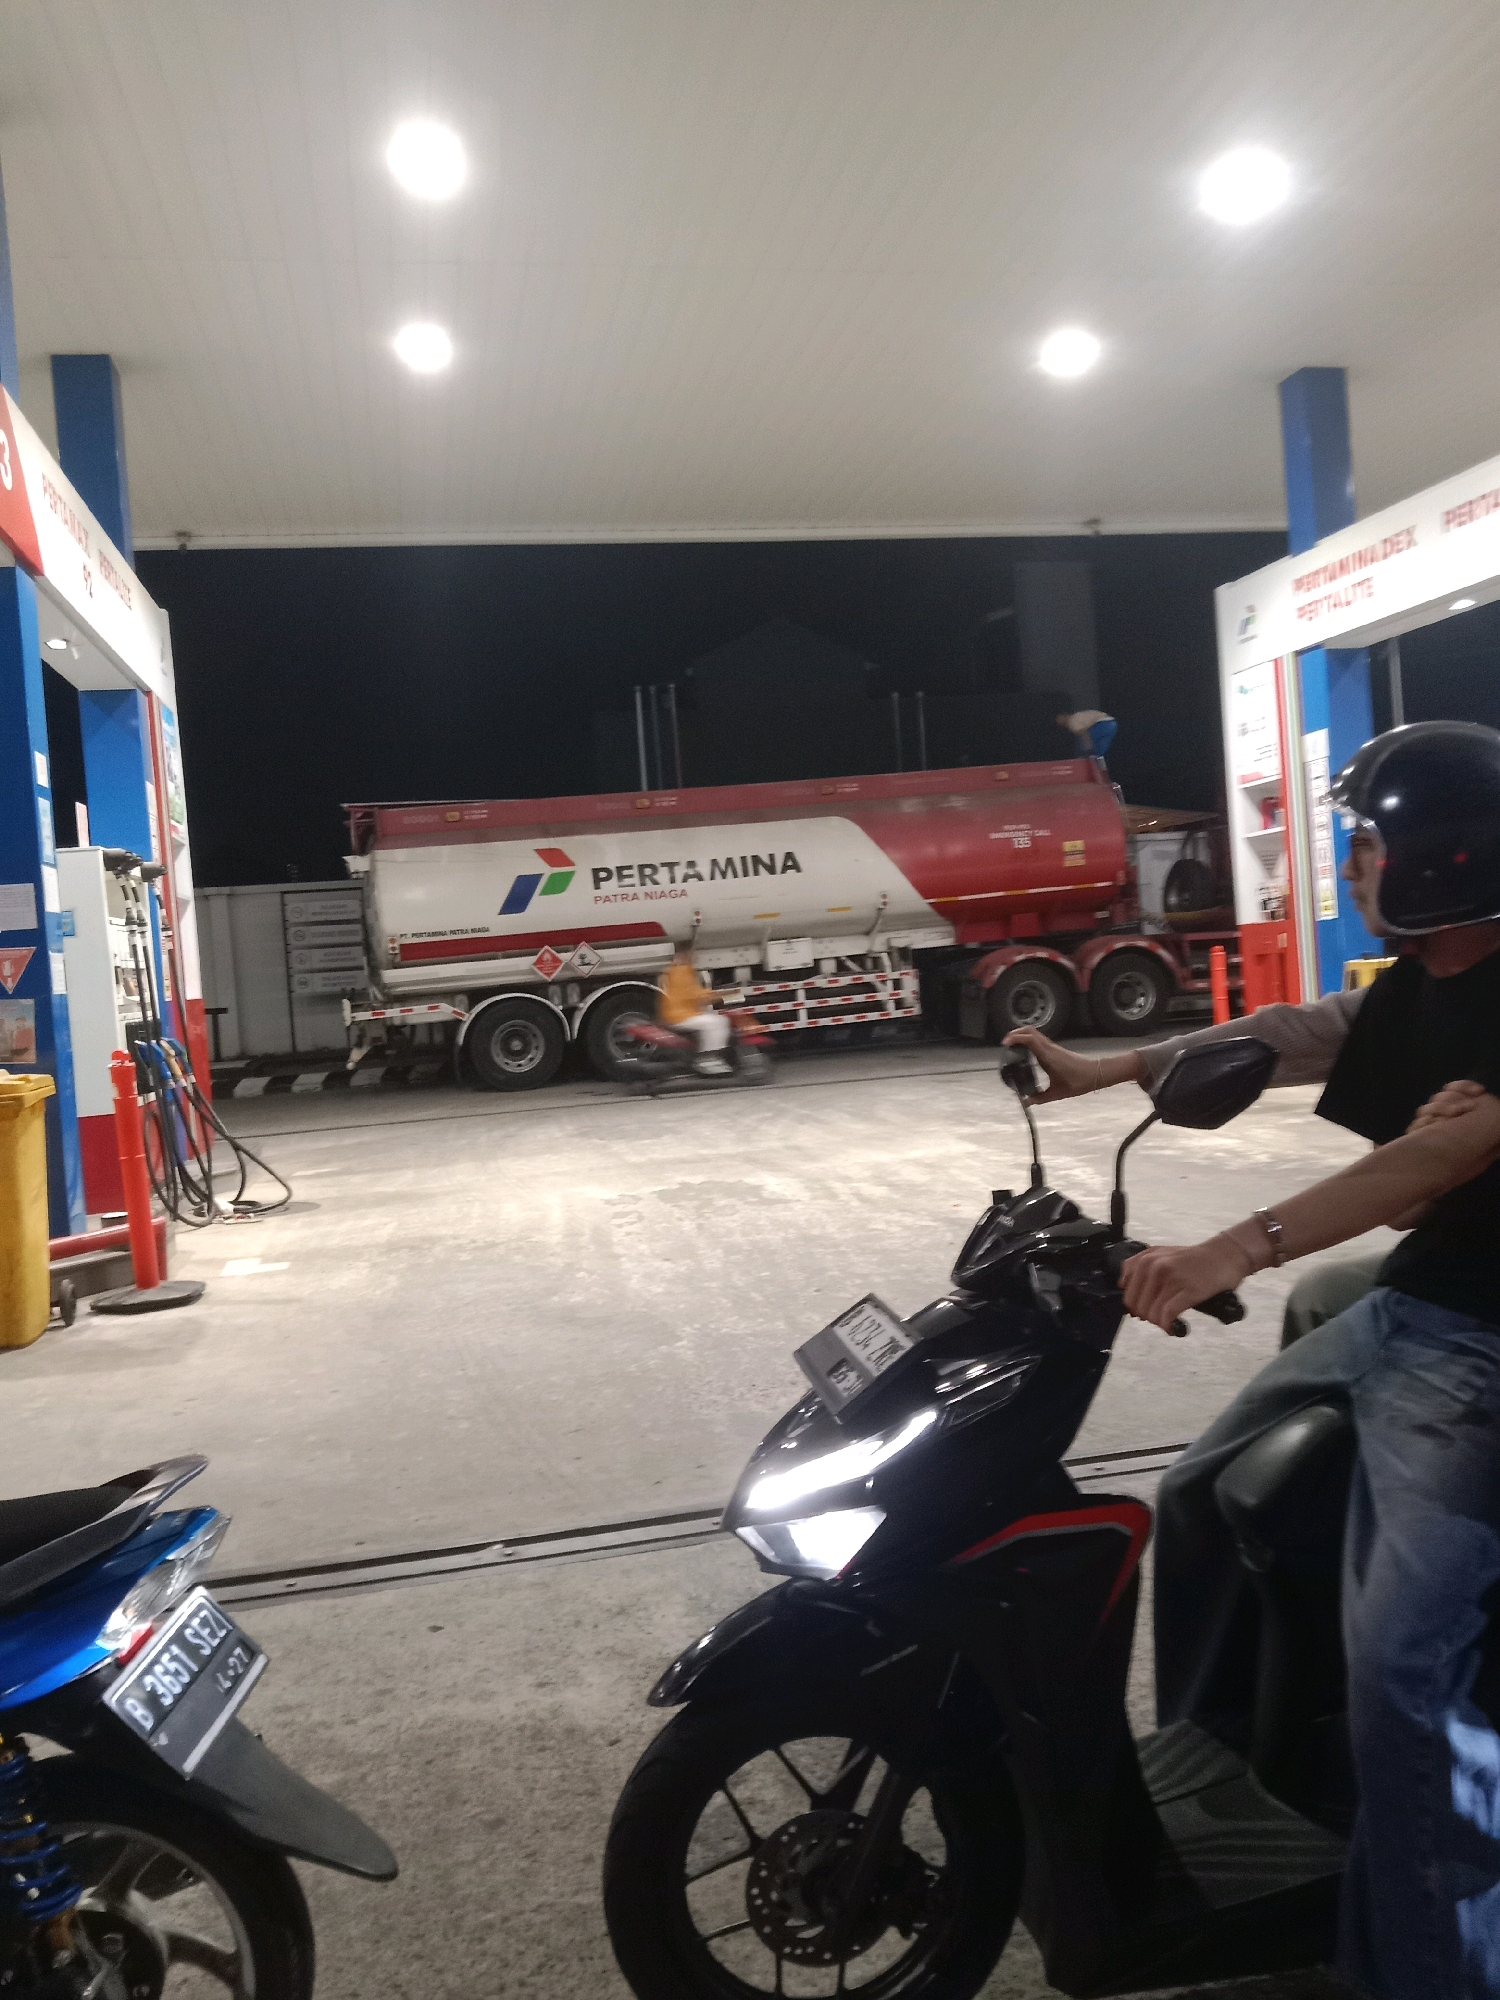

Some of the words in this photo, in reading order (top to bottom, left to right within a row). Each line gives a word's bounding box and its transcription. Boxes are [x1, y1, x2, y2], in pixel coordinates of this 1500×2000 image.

[591, 851, 803, 890] PERTAMINA
[593, 892, 640, 905] PATRA
[644, 888, 689, 901] NIAGA
[124, 1697, 155, 1731] B
[142, 1644, 200, 1707] 3651
